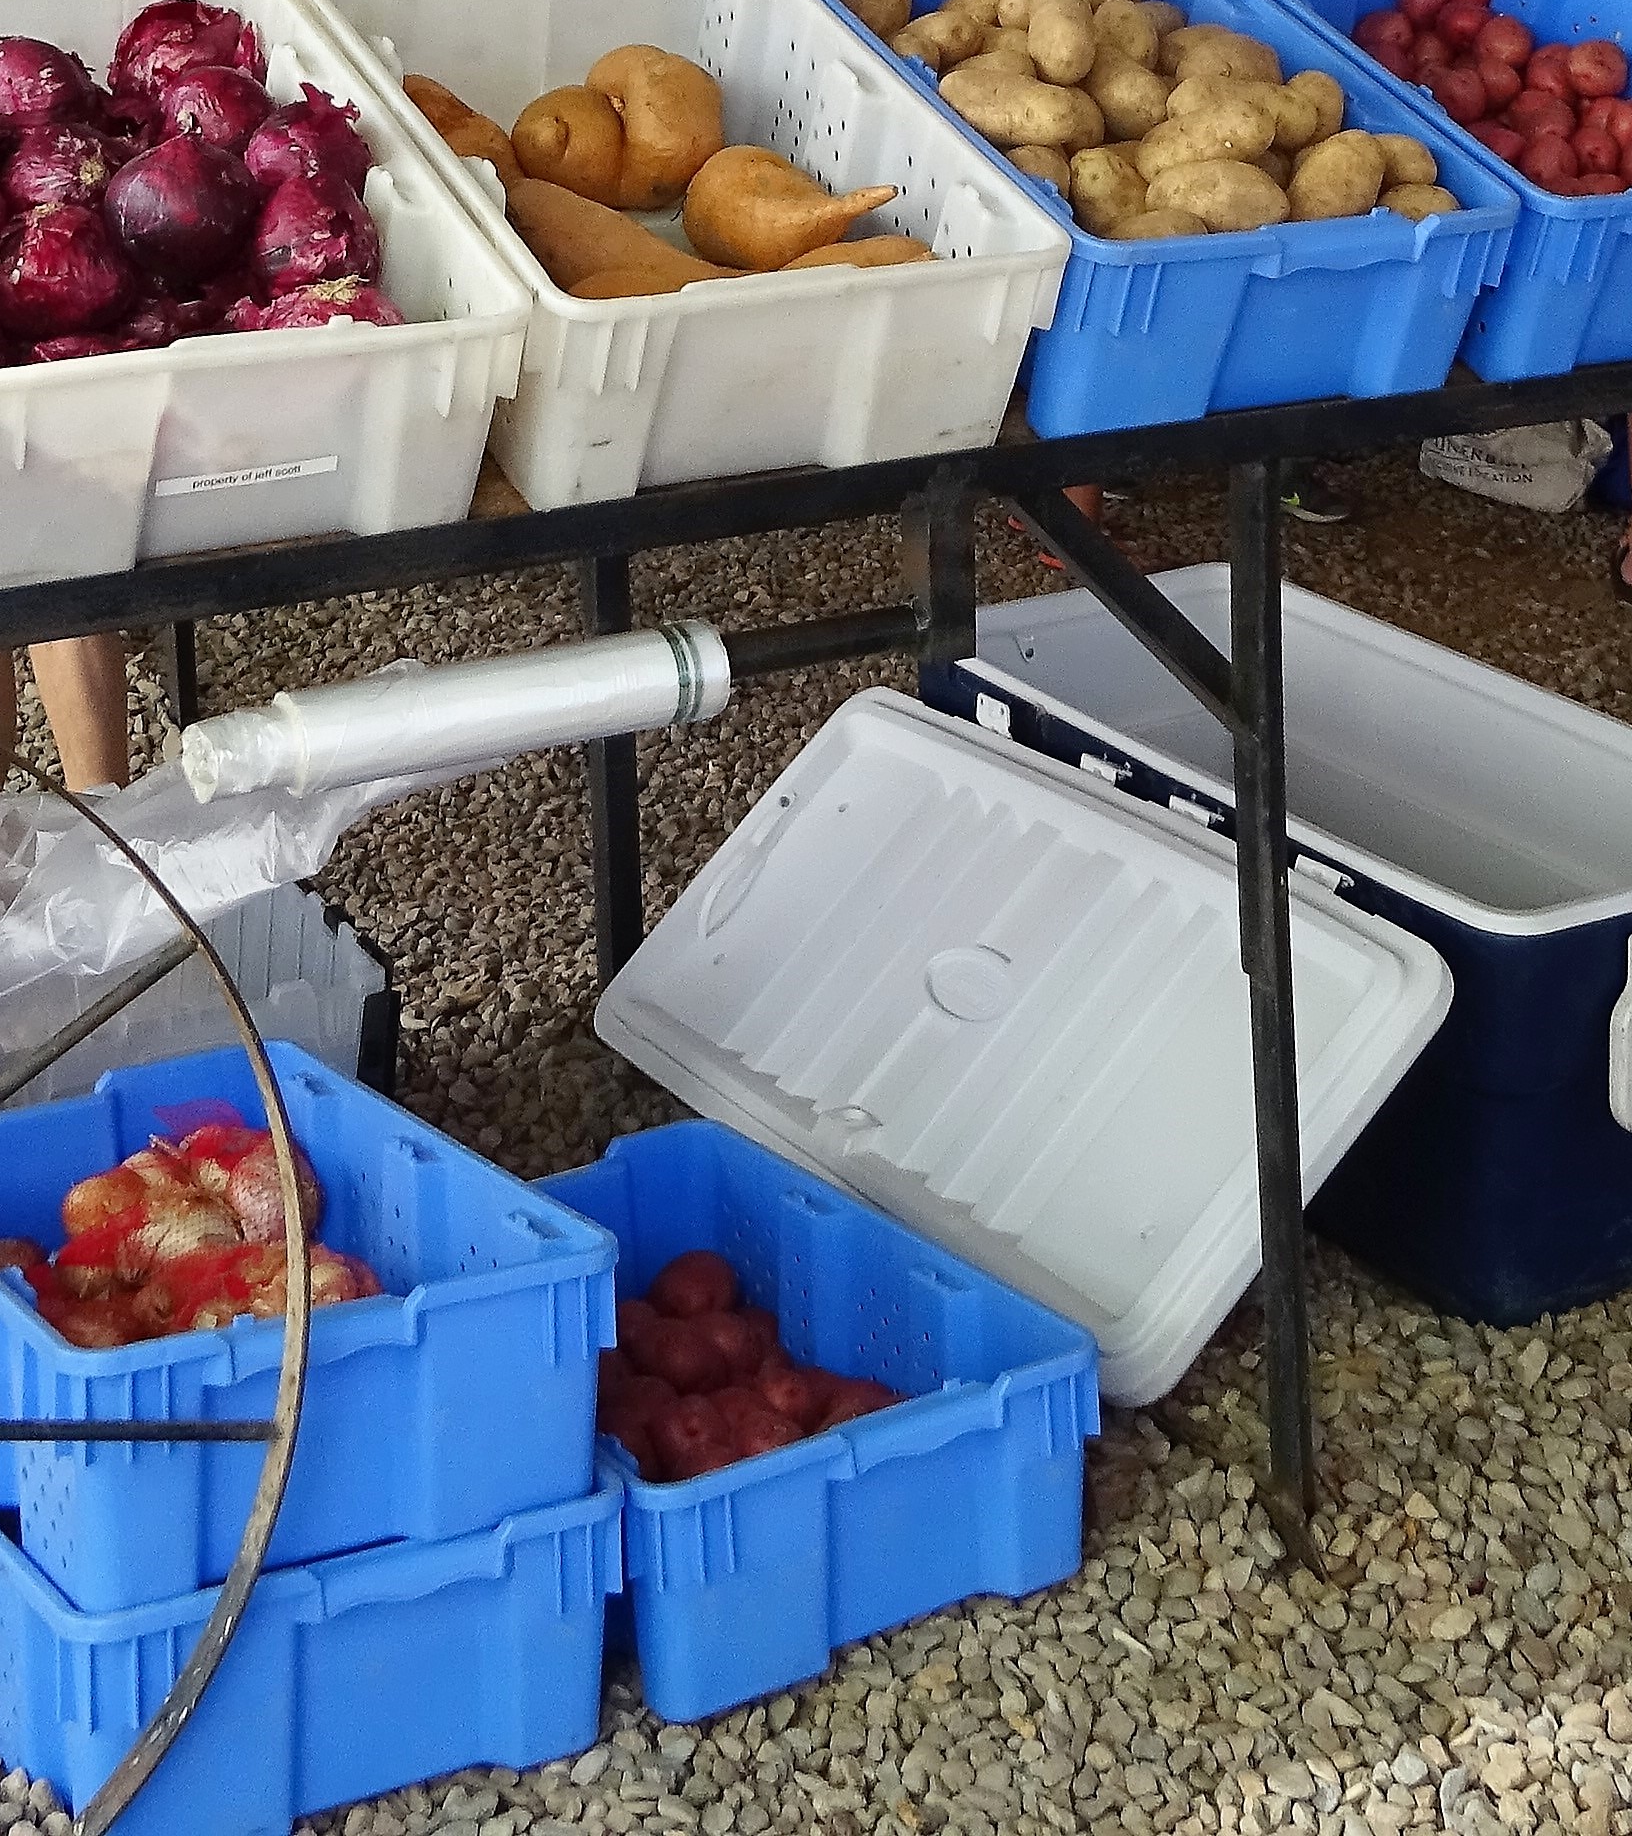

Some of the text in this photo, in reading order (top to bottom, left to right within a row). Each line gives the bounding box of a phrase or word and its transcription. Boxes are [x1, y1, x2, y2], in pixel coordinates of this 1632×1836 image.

[192, 465, 301, 489] property of jeff scott
